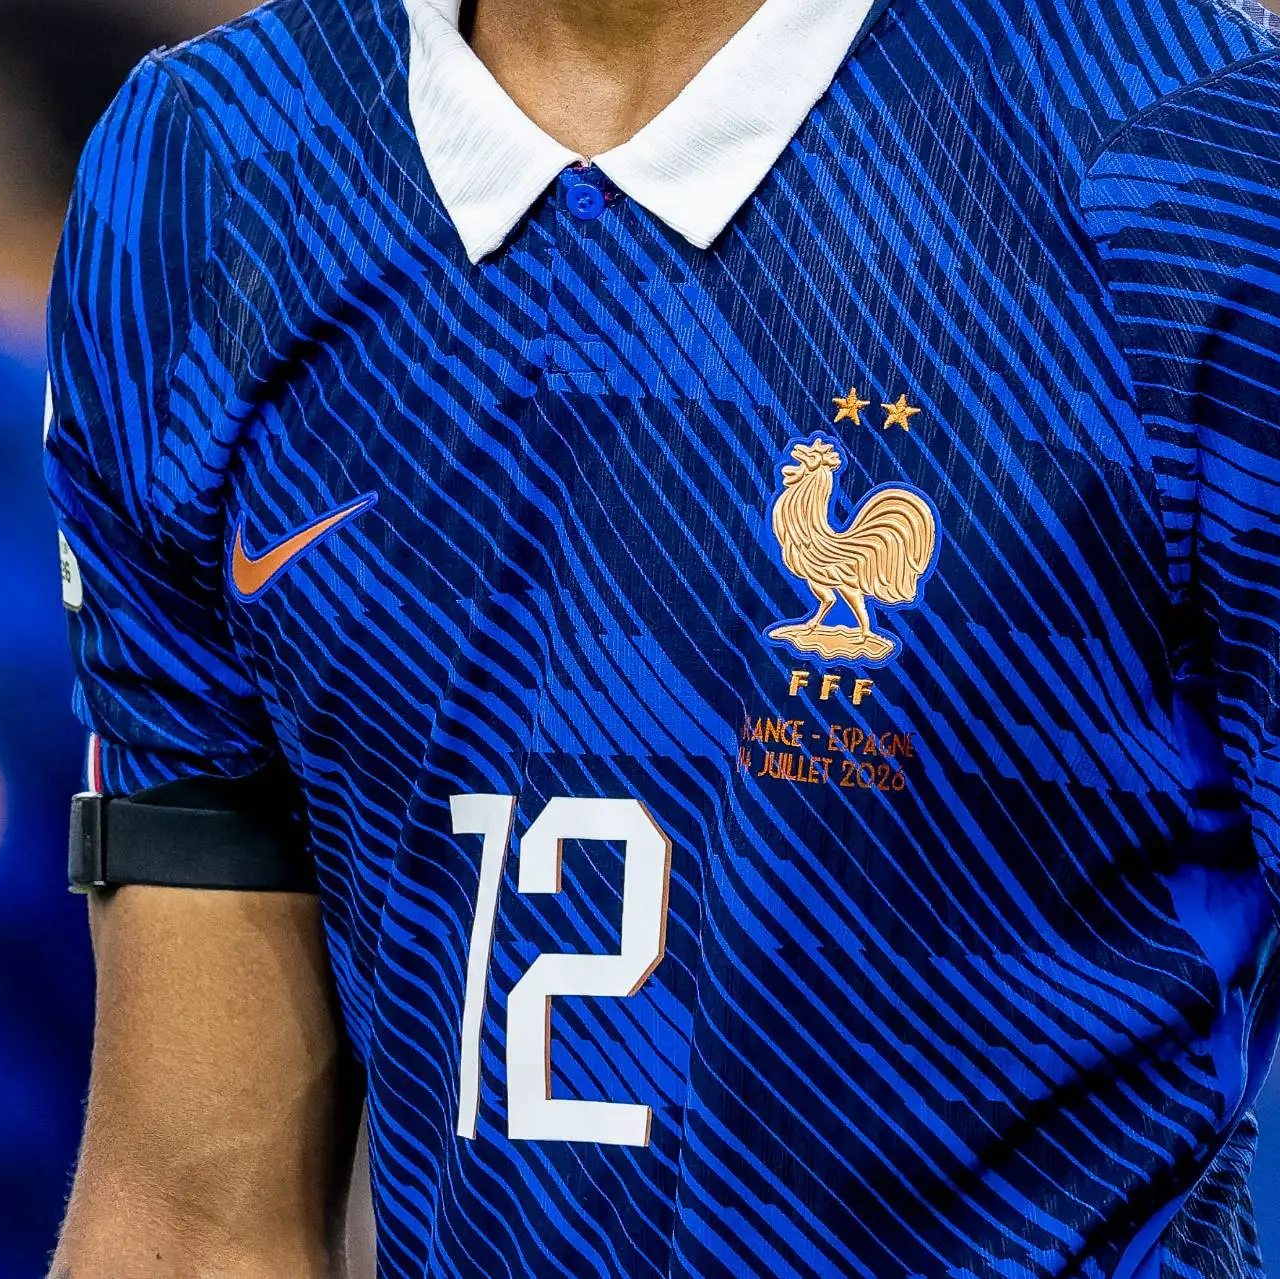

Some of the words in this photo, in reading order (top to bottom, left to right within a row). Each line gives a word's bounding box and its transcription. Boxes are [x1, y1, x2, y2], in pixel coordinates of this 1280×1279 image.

[828, 724, 915, 758] ESPAGNE
[757, 751, 833, 784] JUILLET
[839, 760, 906, 791] 2026
[449, 793, 673, 1148] 12
